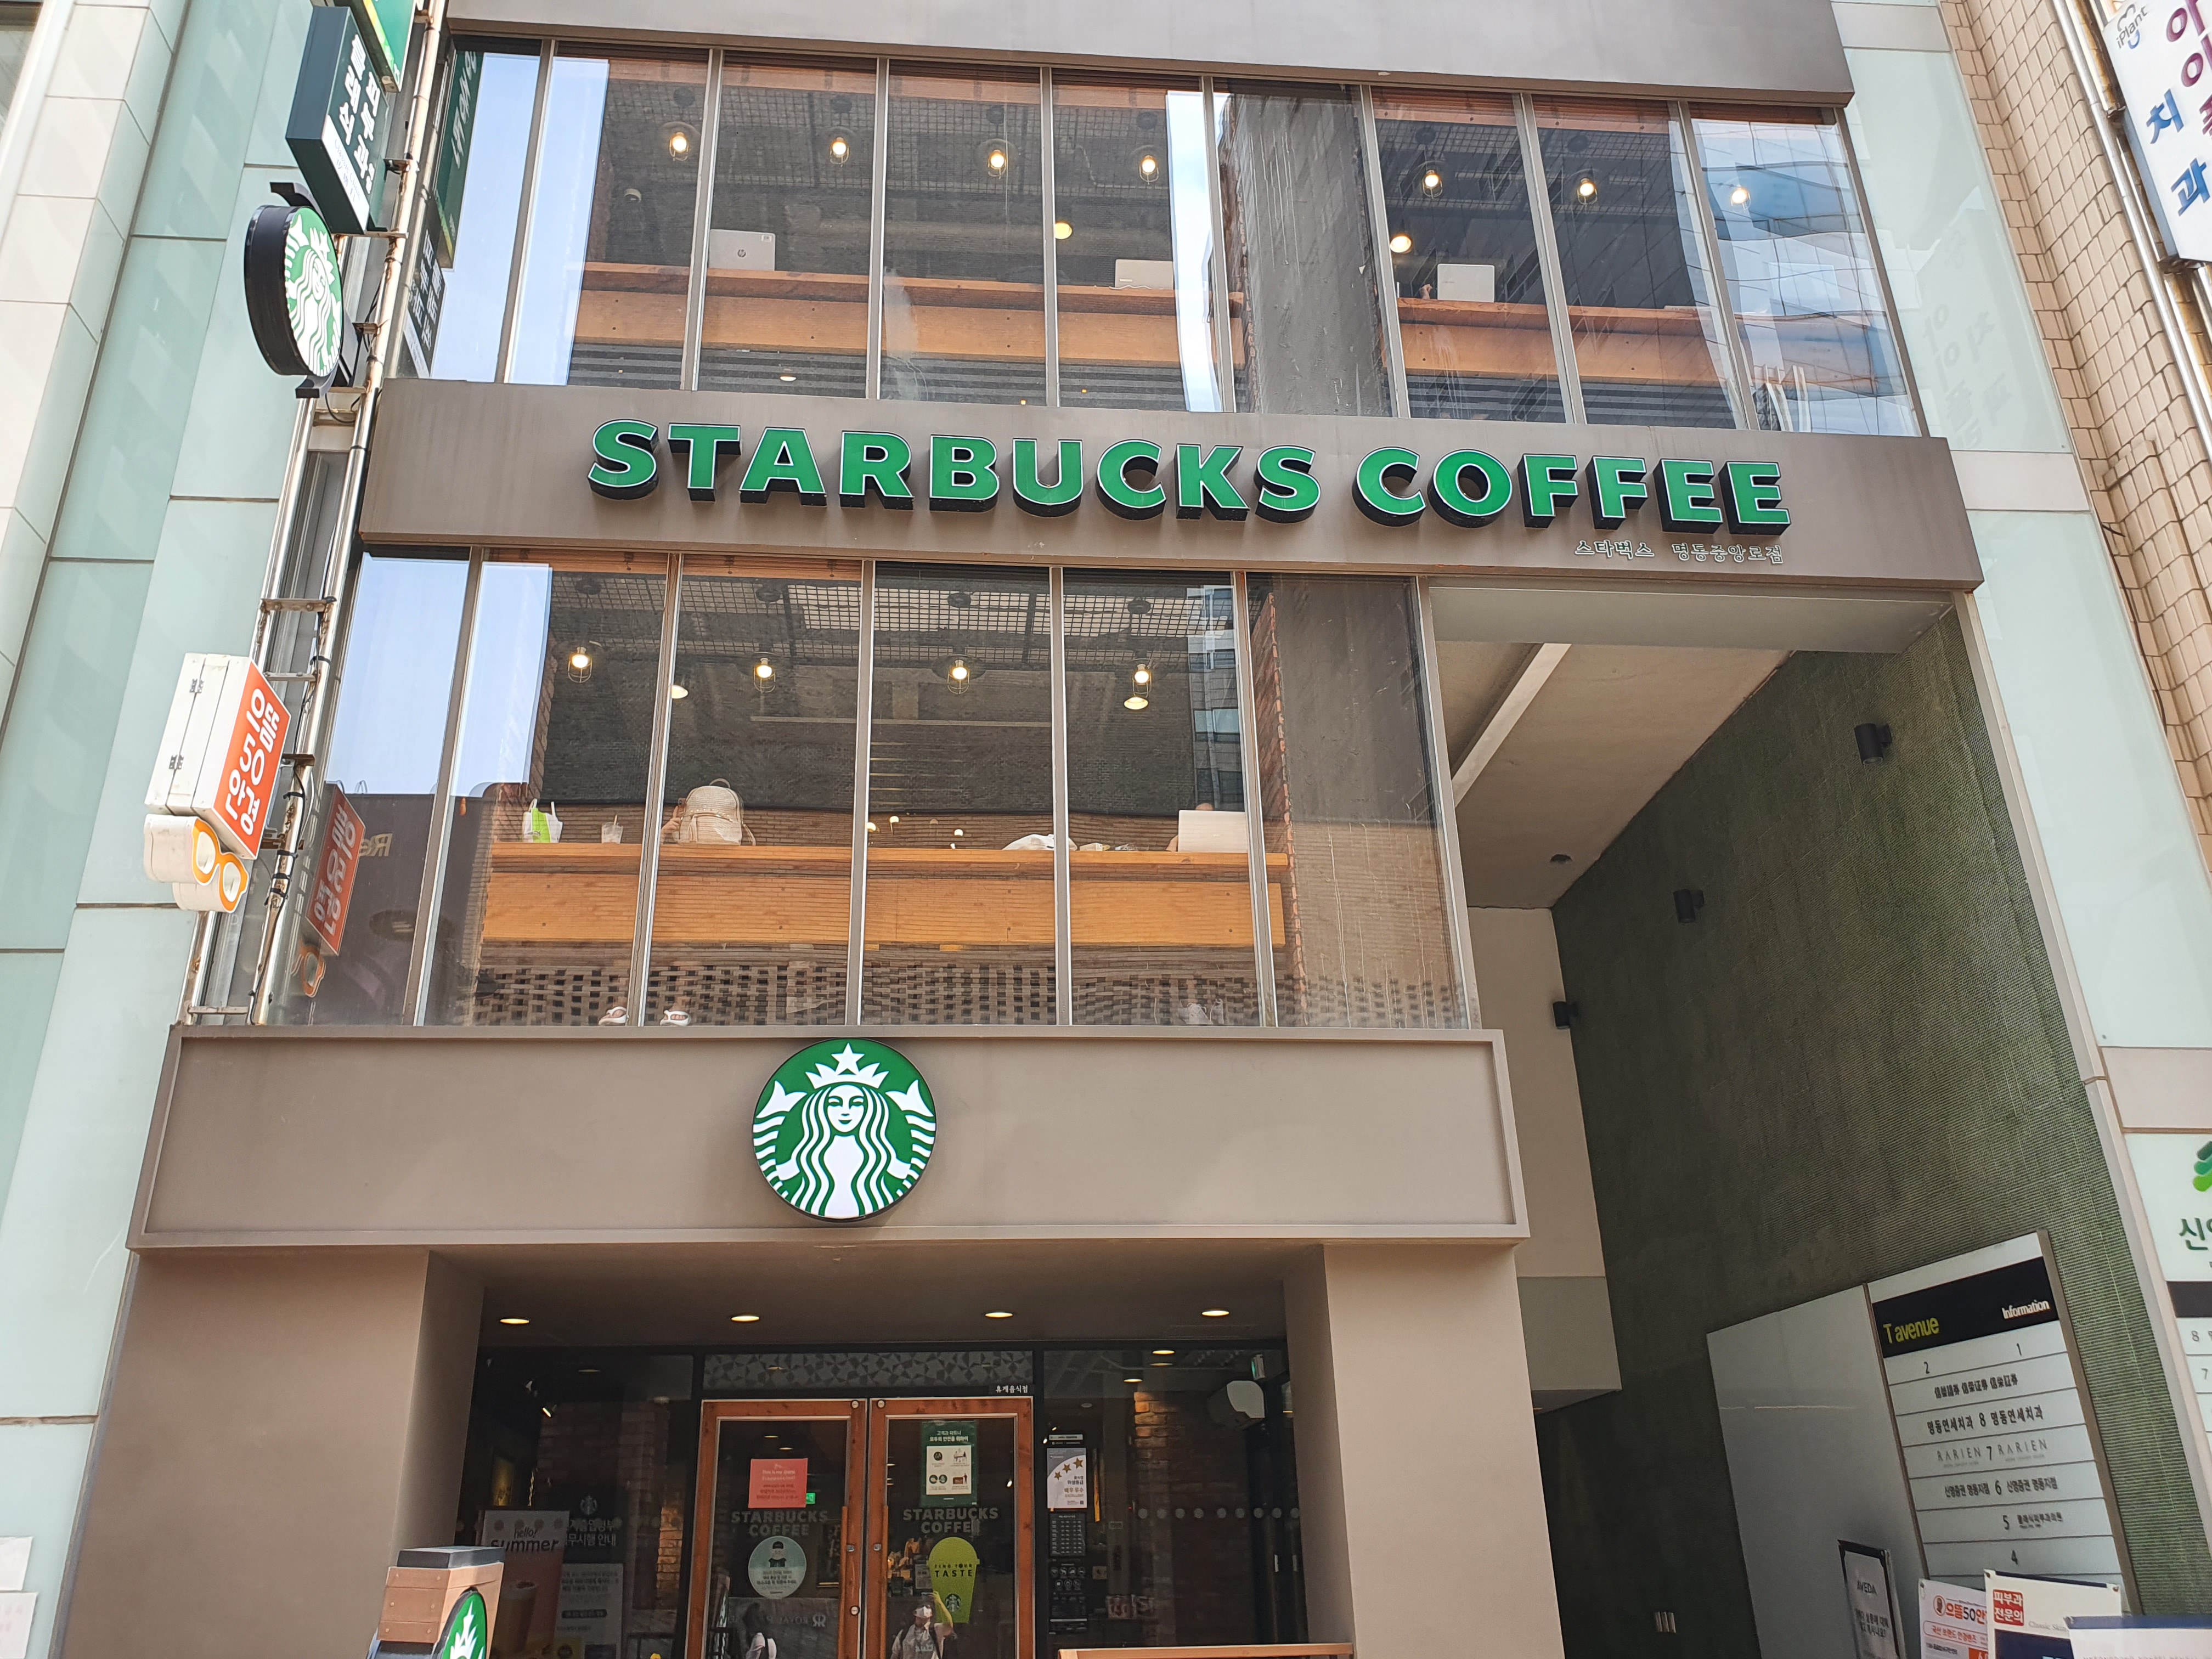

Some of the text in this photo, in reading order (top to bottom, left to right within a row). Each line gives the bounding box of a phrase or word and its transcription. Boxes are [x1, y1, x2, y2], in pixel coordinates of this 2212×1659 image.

[2116, 6, 2149, 49] iPlant
[339, 34, 366, 145] 클래식
[353, 71, 380, 179] 피부과
[2146, 88, 2210, 216] 치과
[588, 418, 1792, 535] STARBUCKS COFFEE
[1574, 539, 1784, 564] 스타벅스 명동중앙로점
[247, 688, 280, 750] 으뜸
[239, 733, 265, 786] 50
[225, 768, 261, 836] 안경
[2002, 1299, 2051, 1319] Information
[1883, 1317, 1940, 1344] T avenue
[2192, 1330, 2199, 1342] 8
[2016, 1343, 2022, 1356] 1
[1923, 1361, 1930, 1374] 2
[2201, 1368, 2208, 1380] 7
[995, 1385, 1028, 1393] 휴게음식점
[1927, 1404, 2044, 1435] 명동연세치과 8 명동연세치과
[1937, 1447, 1982, 1462] RARIEN
[1986, 1446, 1992, 1460] 7
[1997, 1439, 2047, 1454] RARIEN
[1944, 1484, 1967, 1498] 신영증권
[1995, 1480, 2002, 1496] 6
[2007, 1480, 2031, 1493] 신영증권
[731, 1510, 827, 1523] STARBUCKS
[903, 1508, 998, 1520] STARBUCKS
[749, 1524, 809, 1536] COFFEE
[921, 1521, 979, 1533] COFFE
[2002, 1515, 2010, 1530] 5
[514, 1526, 537, 1539] hello!
[598, 1533, 616, 1547] 안내
[490, 1539, 560, 1553] summer
[2011, 1550, 2018, 1565] 4
[1857, 1580, 1877, 1595] AVEDA
[1994, 1592, 2023, 1606] 피부과
[1945, 1602, 1987, 1624] 으뜸50안
[1995, 1607, 2023, 1623] 전문의
